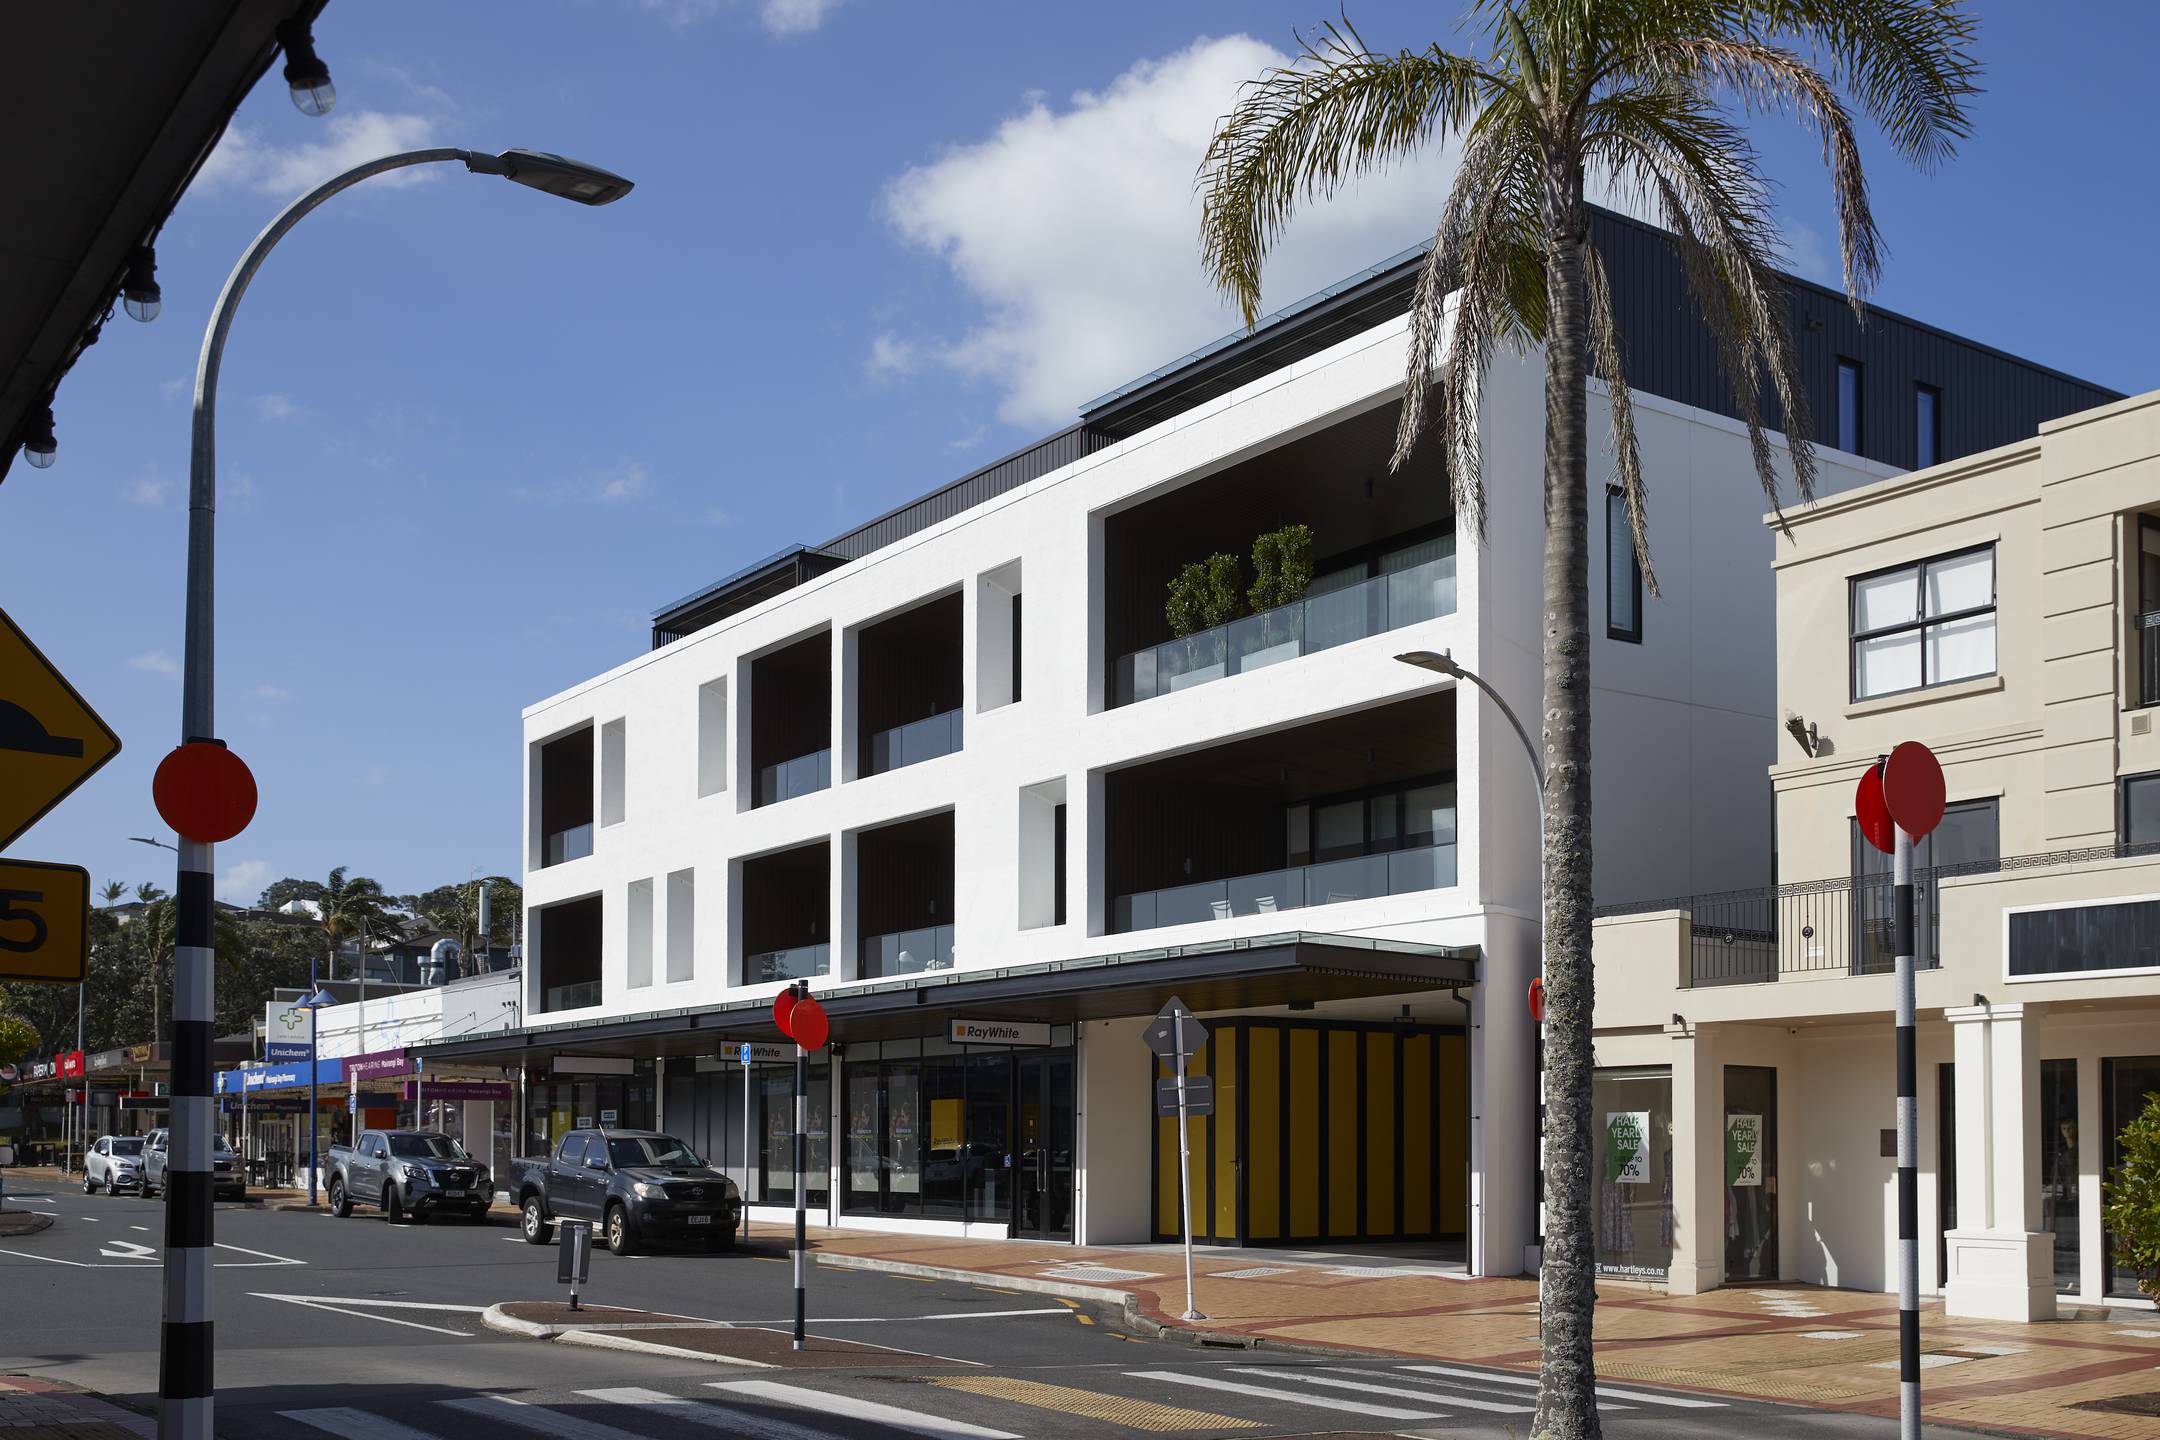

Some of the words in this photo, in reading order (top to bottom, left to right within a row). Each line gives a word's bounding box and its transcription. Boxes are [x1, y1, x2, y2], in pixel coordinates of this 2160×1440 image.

[967, 1026, 1020, 1039] RayWhite
[271, 1049, 307, 1057] Unichem
[734, 1047, 781, 1057] RWhite
[1617, 1139, 1639, 1150] SALE
[1736, 1142, 1754, 1153] SALE
[1602, 1264, 1665, 1277] www.hartleys.co.nz
